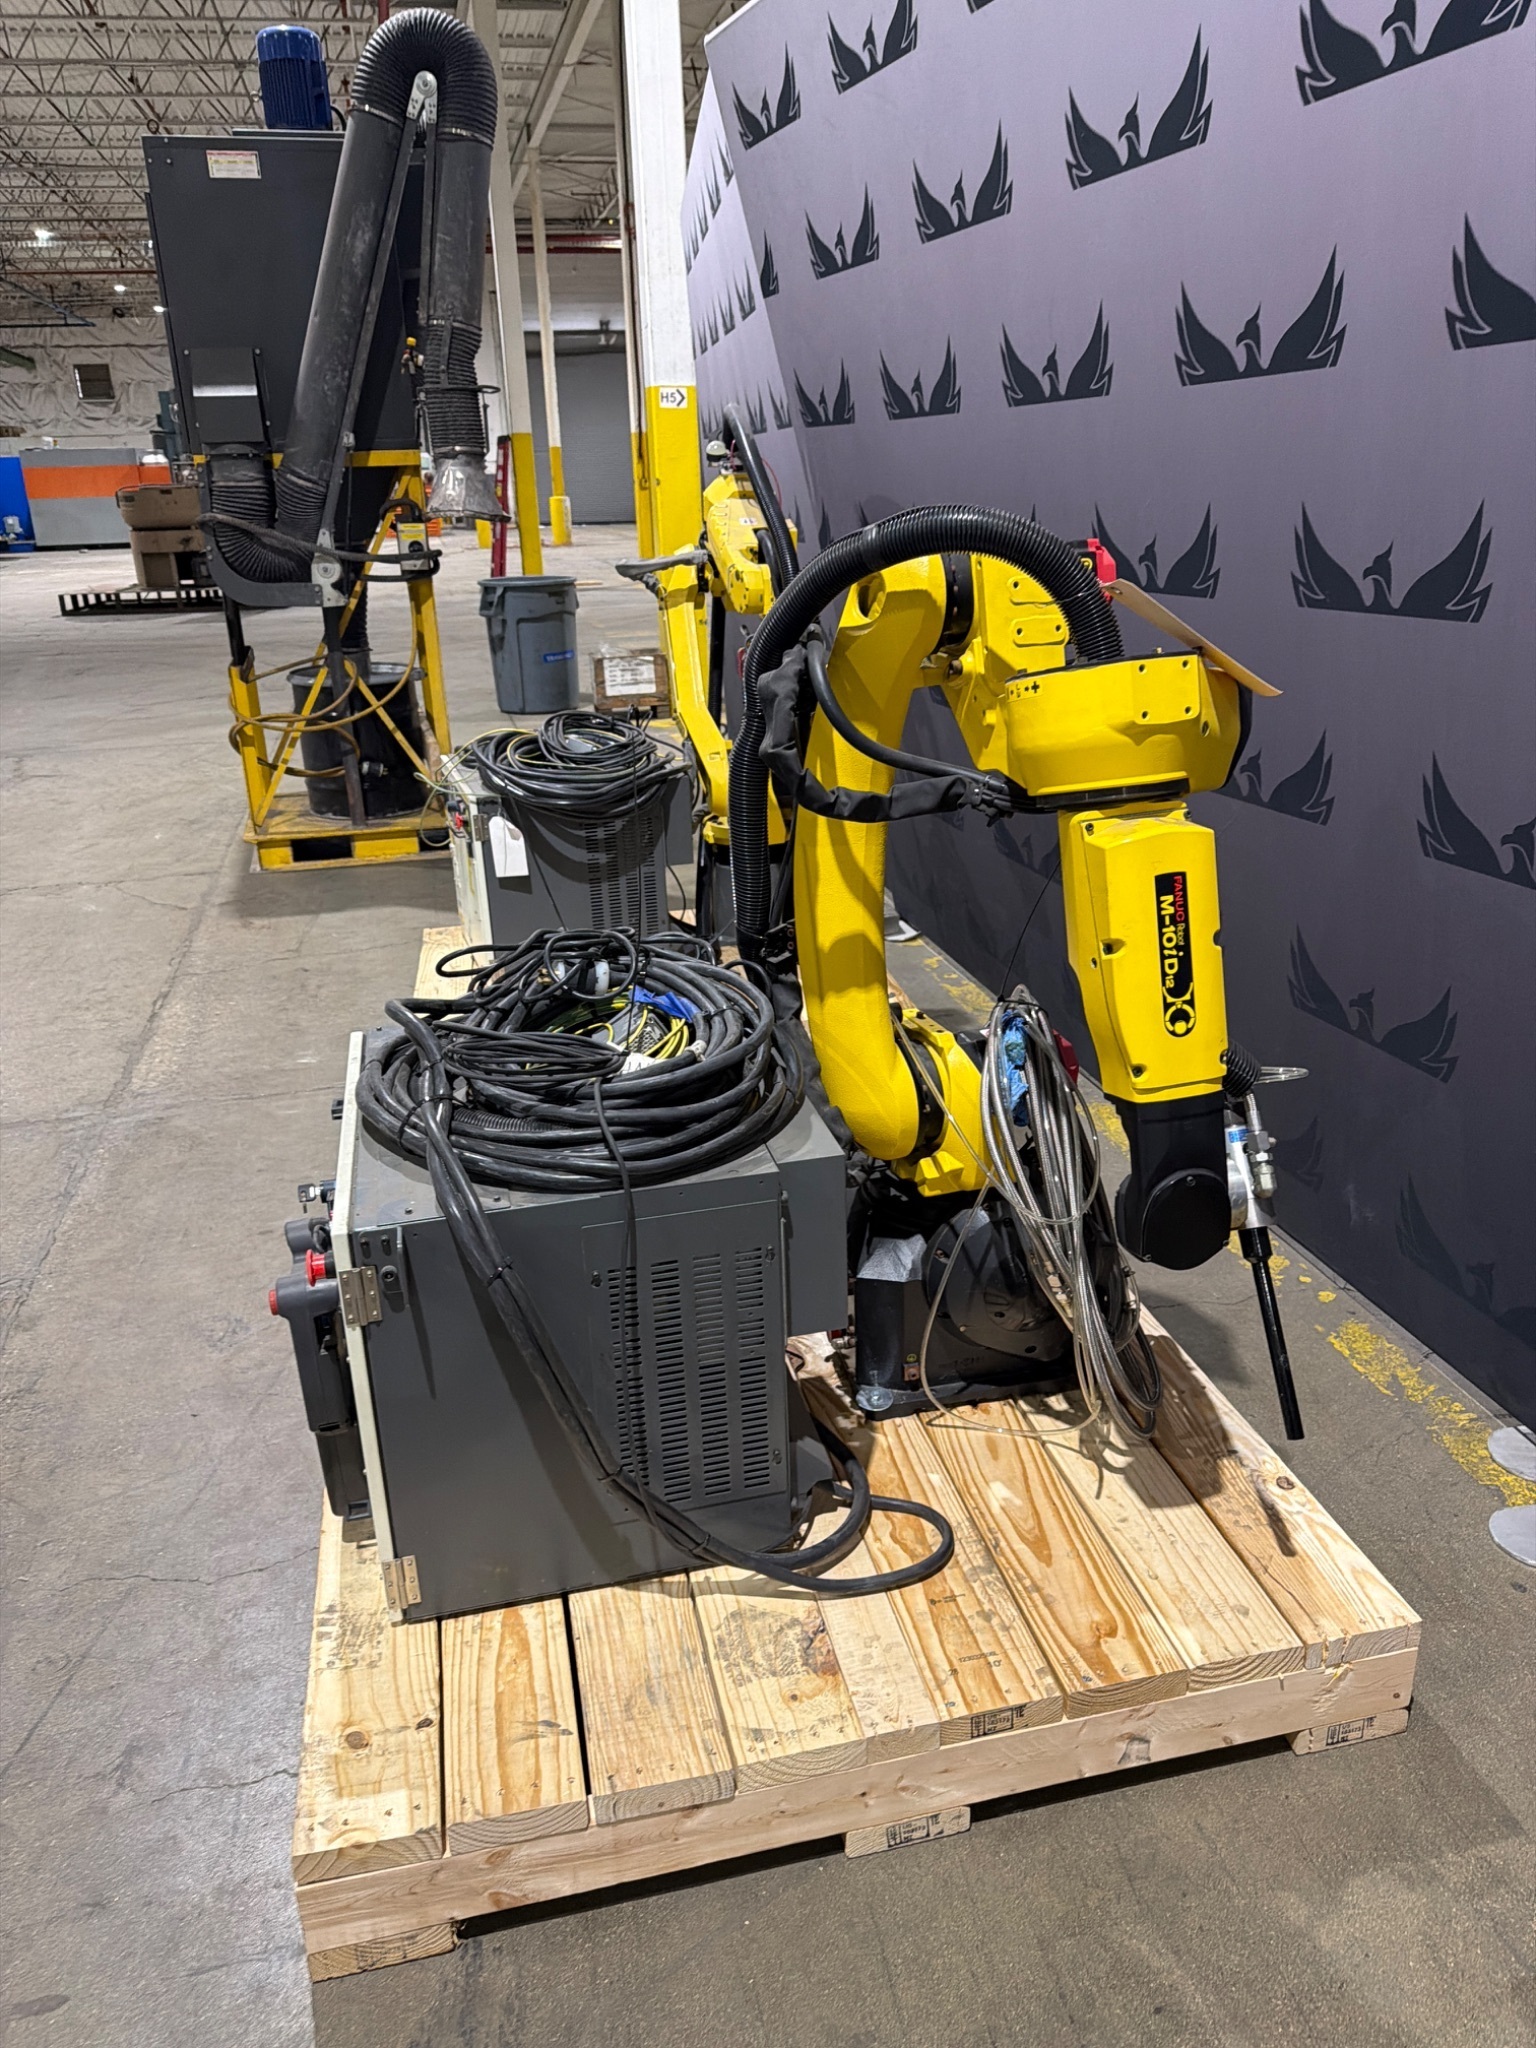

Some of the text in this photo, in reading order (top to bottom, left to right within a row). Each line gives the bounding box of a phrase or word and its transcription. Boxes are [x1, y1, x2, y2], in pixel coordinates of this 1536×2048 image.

[660, 391, 677, 404] H5
[1173, 875, 1185, 945] FANUC Robot
